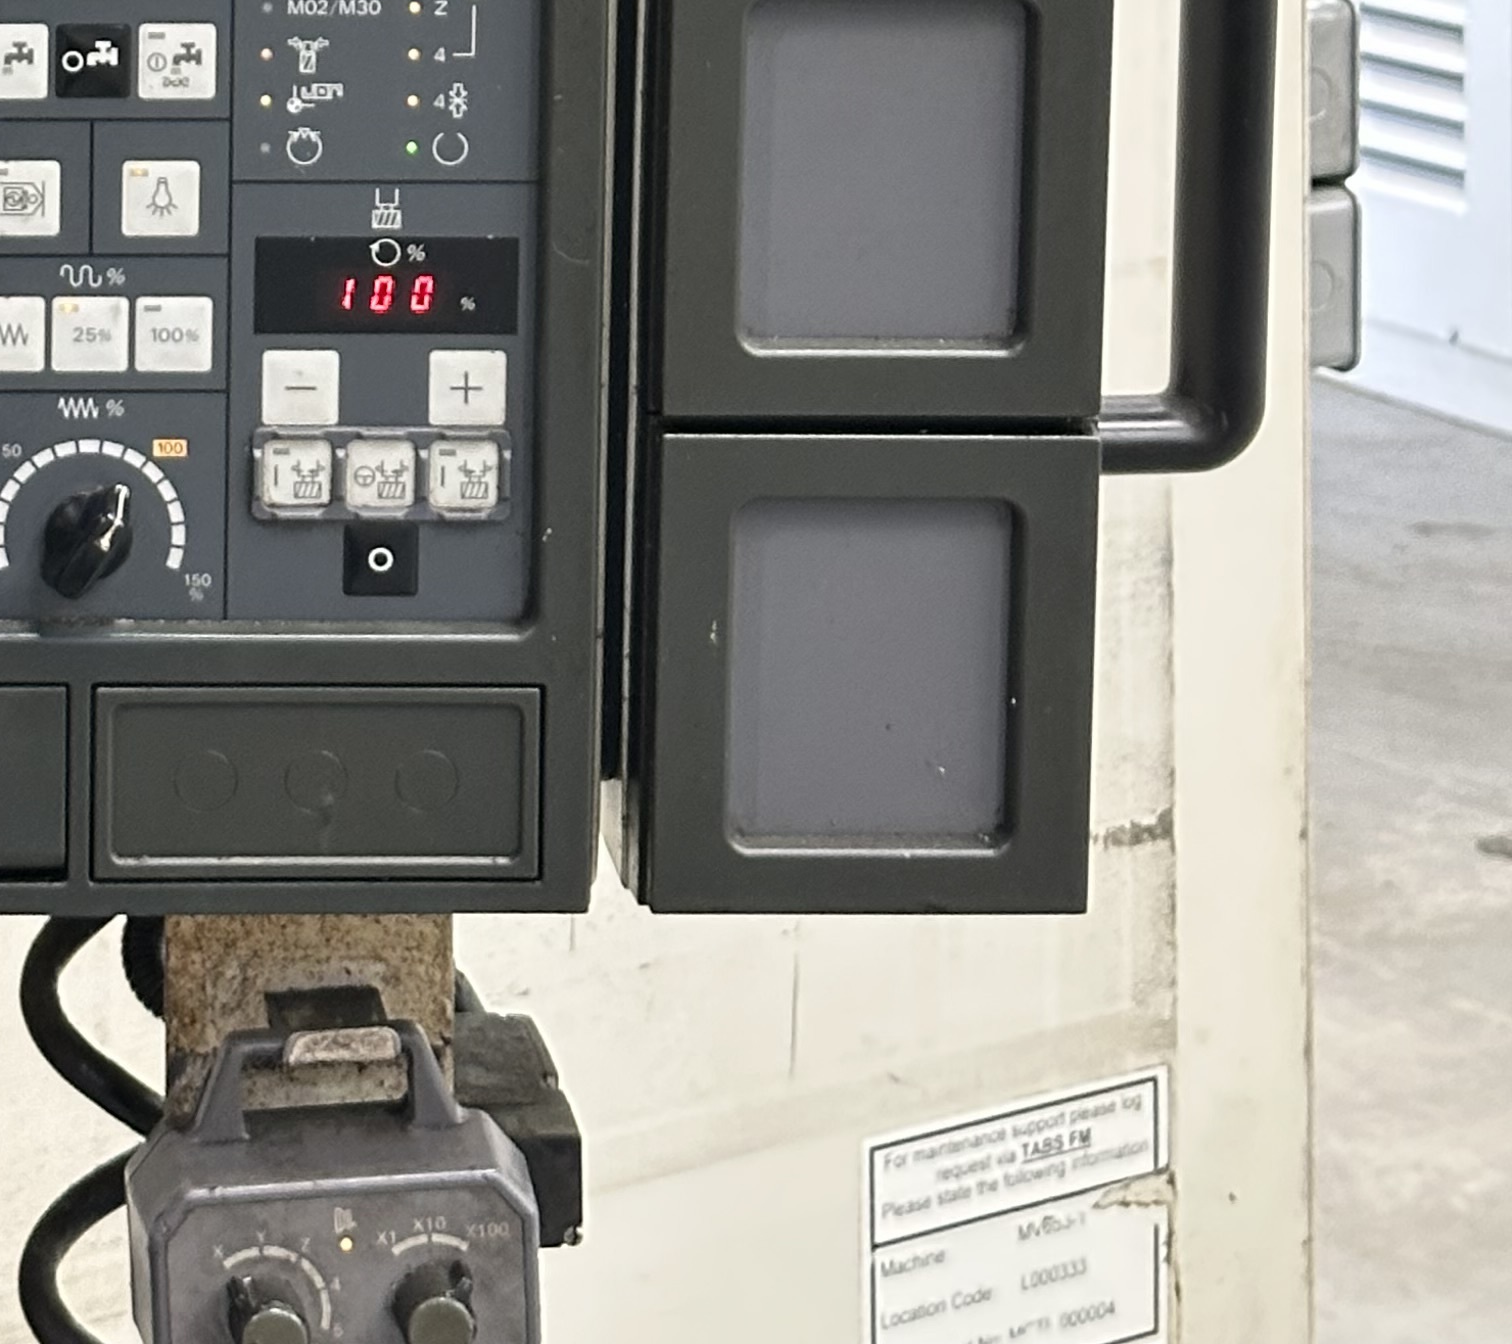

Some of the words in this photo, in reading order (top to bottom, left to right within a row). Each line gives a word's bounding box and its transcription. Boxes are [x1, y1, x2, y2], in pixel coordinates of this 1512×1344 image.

[288, 0, 381, 15] M02/M30
[341, 275, 434, 312] 100
[73, 328, 111, 342] 25%
[152, 328, 199, 342] 100%
[2, 444, 22, 458] 50
[157, 441, 184, 455] 100
[185, 573, 212, 587] 150
[1022, 1134, 1065, 1159] TABS
[1068, 1127, 1091, 1148] FM
